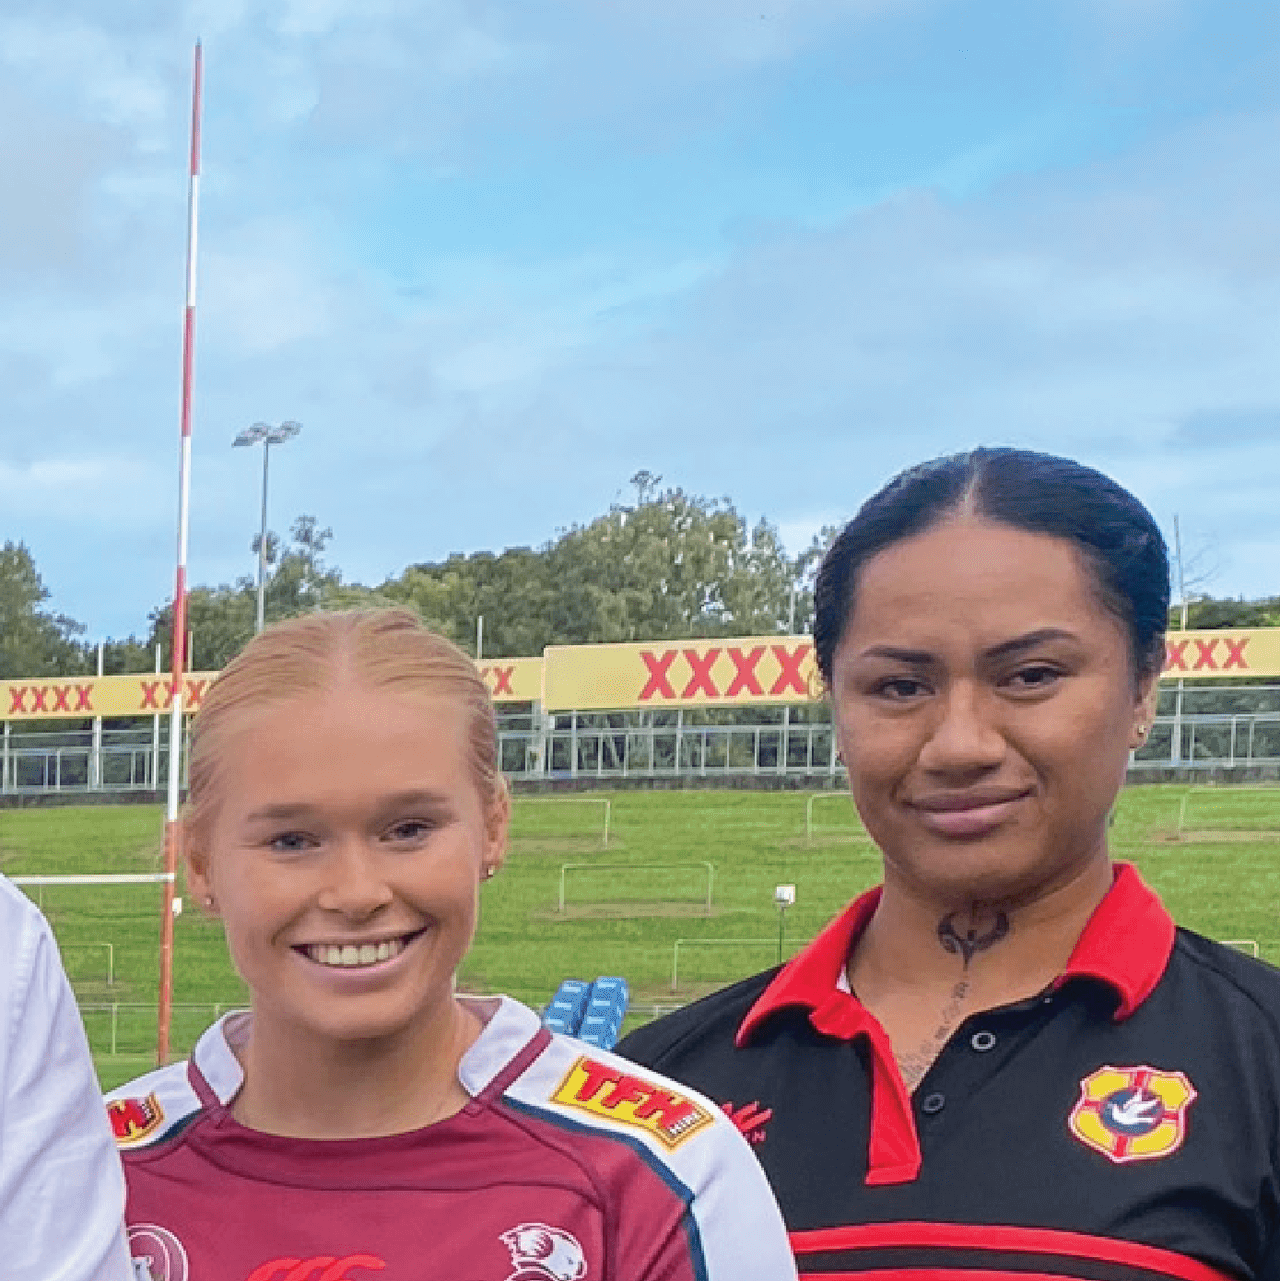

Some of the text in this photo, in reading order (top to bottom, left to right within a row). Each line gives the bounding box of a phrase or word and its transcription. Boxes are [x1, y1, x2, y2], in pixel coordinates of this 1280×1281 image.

[638, 645, 812, 700] XXXX
[1165, 637, 1253, 671] XXX
[7, 684, 95, 714] XXXX
[575, 1058, 697, 1131] TFH
